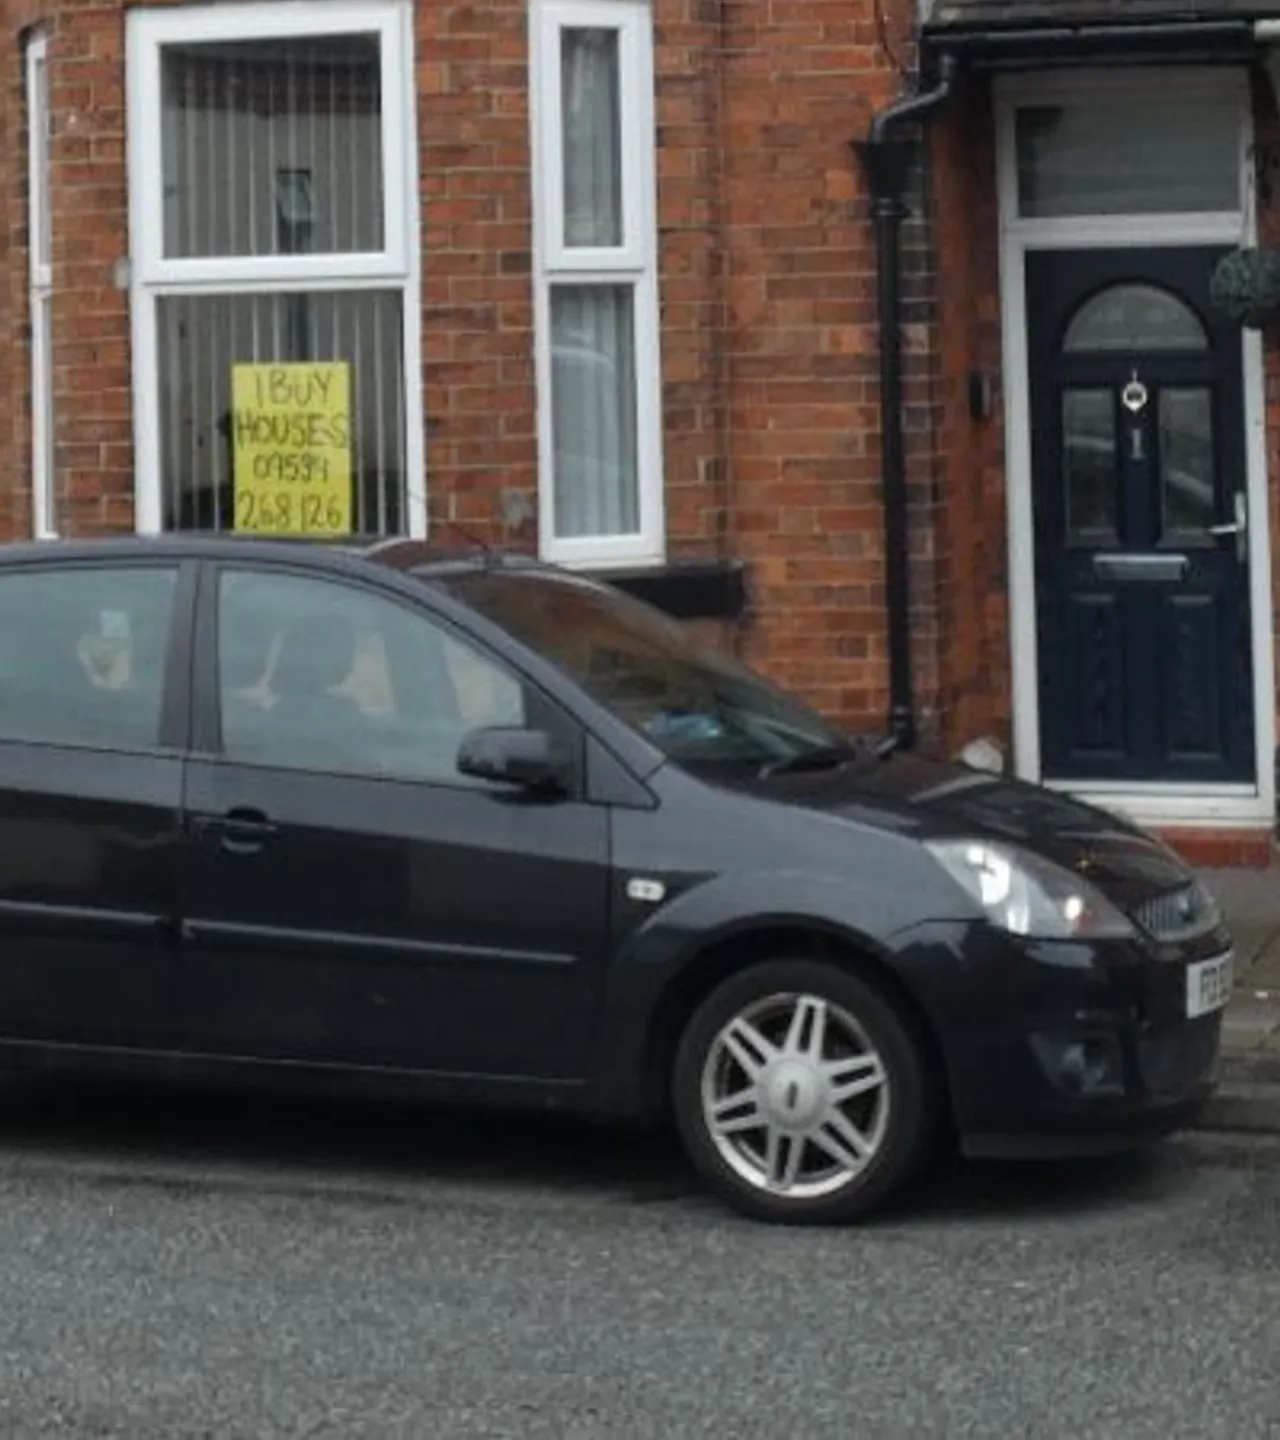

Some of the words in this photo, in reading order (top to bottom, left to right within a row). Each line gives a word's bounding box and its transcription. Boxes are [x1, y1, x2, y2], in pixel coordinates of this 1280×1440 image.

[270, 368, 333, 407] BUY
[236, 409, 349, 450] HOUSES
[1128, 427, 1145, 459] 1
